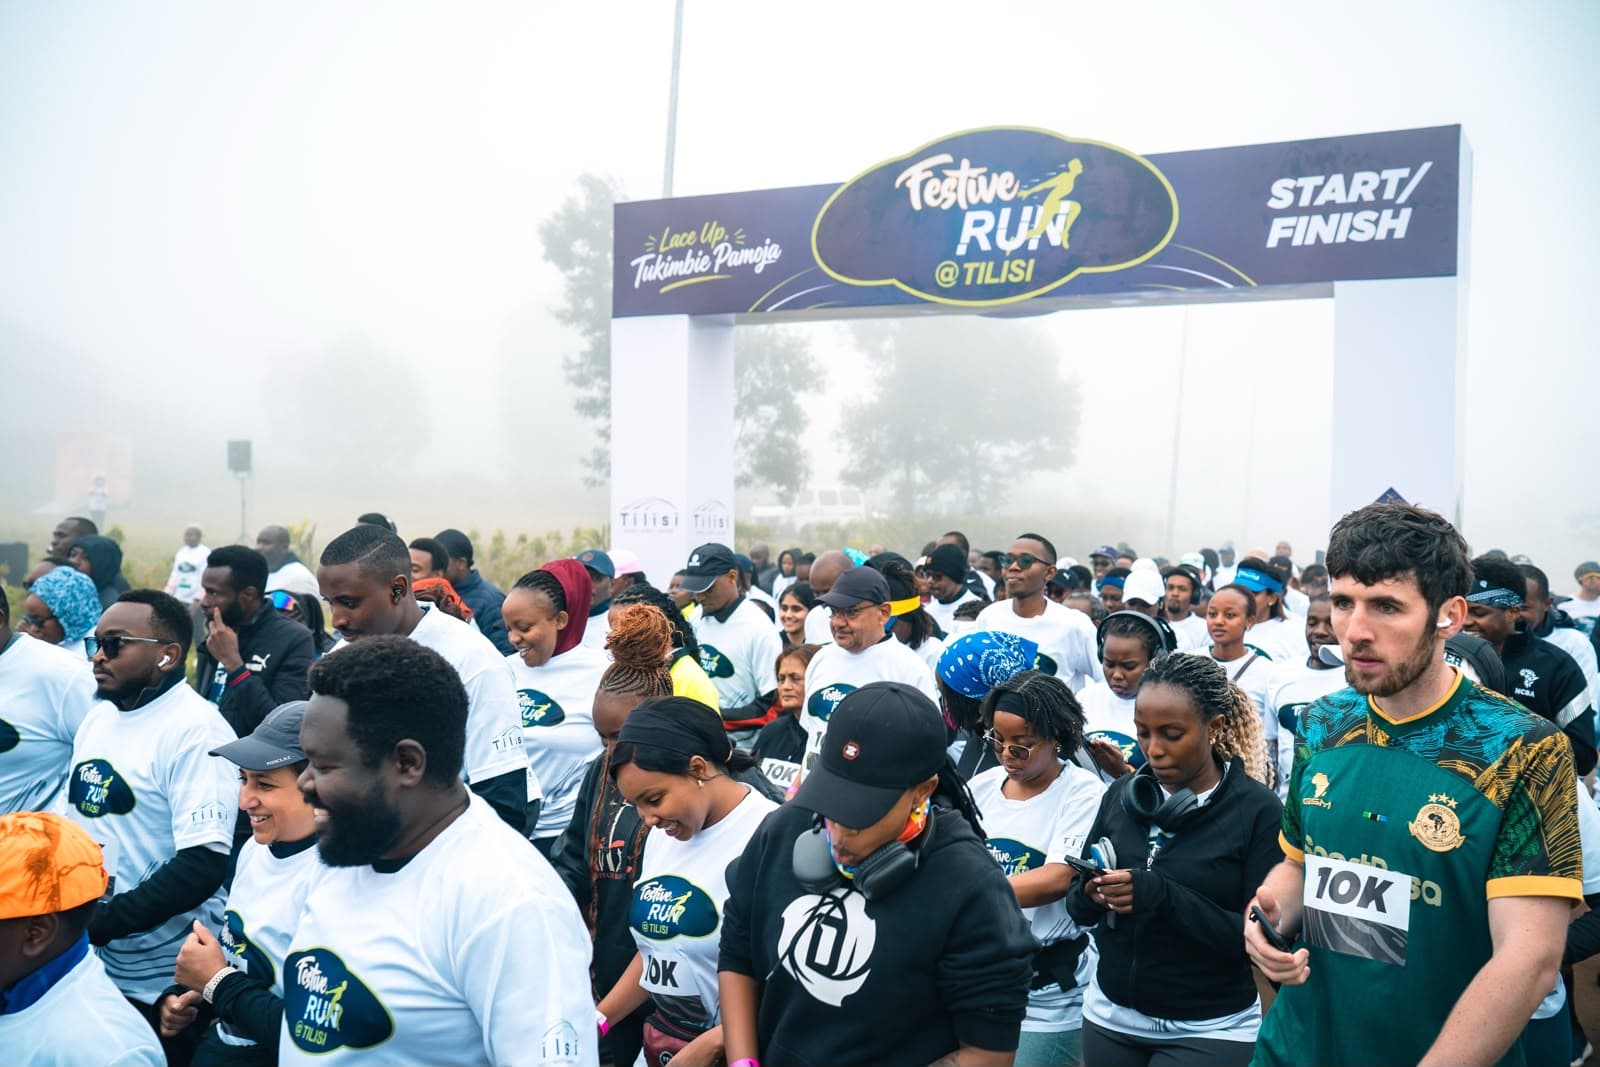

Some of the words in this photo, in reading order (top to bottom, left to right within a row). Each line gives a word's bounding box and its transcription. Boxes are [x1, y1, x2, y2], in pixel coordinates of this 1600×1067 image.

[895, 153, 1020, 212] Festive
[1266, 161, 1433, 210] START/
[659, 226, 697, 253] Lace
[955, 200, 1072, 257] RUN
[1265, 207, 1412, 249] FINISH
[630, 249, 711, 289] Tukimbie
[713, 238, 783, 274] Pamoja
[619, 511, 679, 528] Tilisi
[765, 762, 799, 783] 10K
[640, 881, 673, 902] Festive
[1315, 866, 1394, 914] 10K
[647, 903, 683, 924] RUN
[295, 955, 328, 994] Festive
[644, 954, 679, 988] 10K
[303, 994, 341, 1030] RUN
